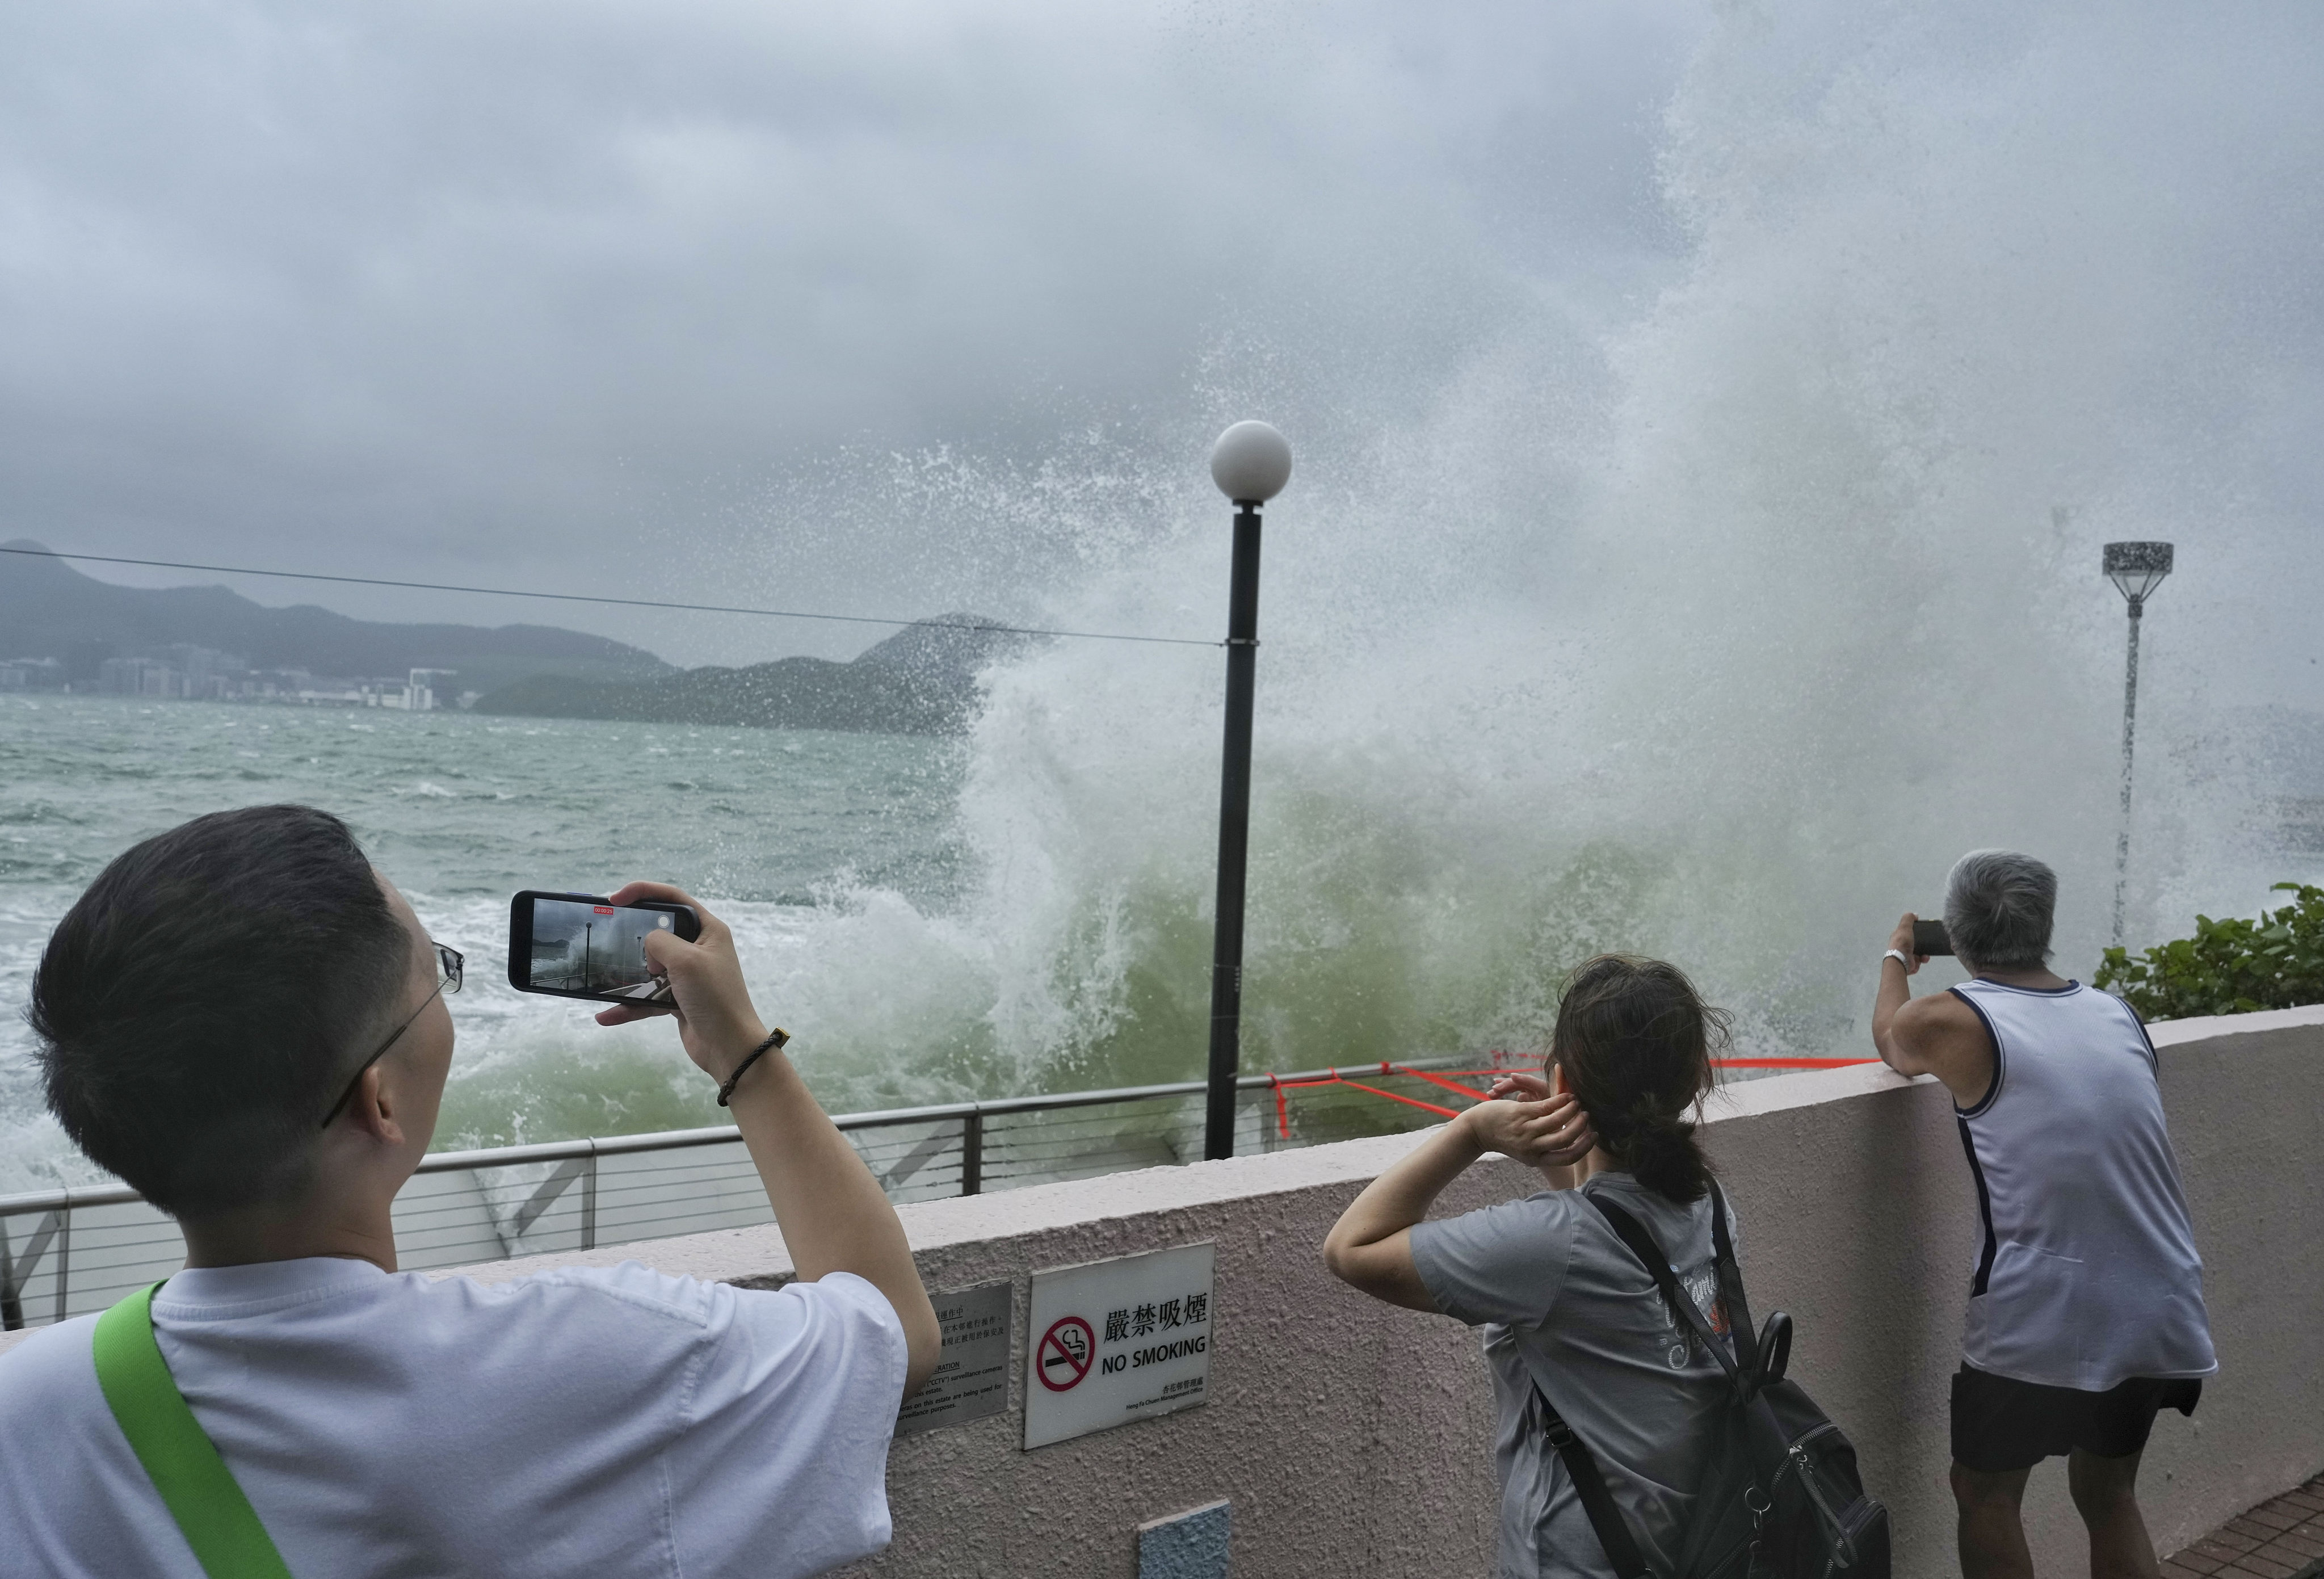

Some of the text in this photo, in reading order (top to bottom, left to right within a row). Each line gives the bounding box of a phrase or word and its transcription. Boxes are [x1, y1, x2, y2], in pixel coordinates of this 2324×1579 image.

[1103, 1292, 1207, 1344] 嚴禁吸煙
[1102, 1336, 1205, 1375] NO SMOKING
[951, 1370, 981, 1381] surveillance
[982, 1365, 1003, 1374] cameras
[925, 1387, 943, 1396] estate.
[935, 1396, 951, 1404] estate
[963, 1388, 978, 1399] being
[980, 1385, 993, 1393] used
[1161, 1390, 1190, 1402] Management
[930, 1402, 956, 1414] purposes.
